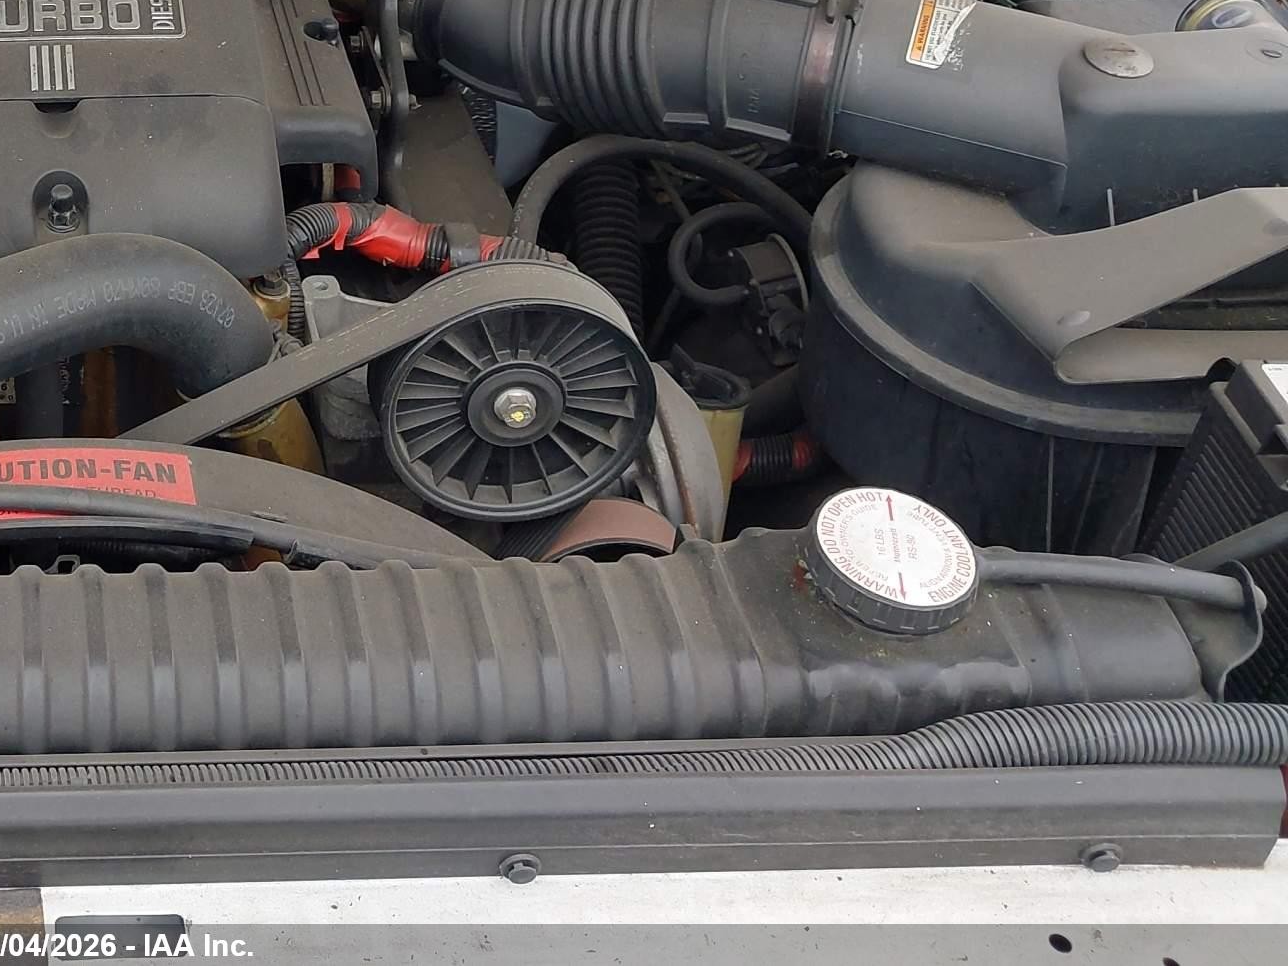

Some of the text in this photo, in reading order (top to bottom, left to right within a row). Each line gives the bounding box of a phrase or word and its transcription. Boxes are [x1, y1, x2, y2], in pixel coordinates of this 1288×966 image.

[53, 287, 97, 319] MADE
[914, 504, 947, 528] ONLY
[820, 491, 899, 599] WARNING DO NOT OPEN HOT
[873, 527, 885, 546] LBS
[943, 529, 972, 578] COOLANT
[928, 576, 968, 603] ENGINE
